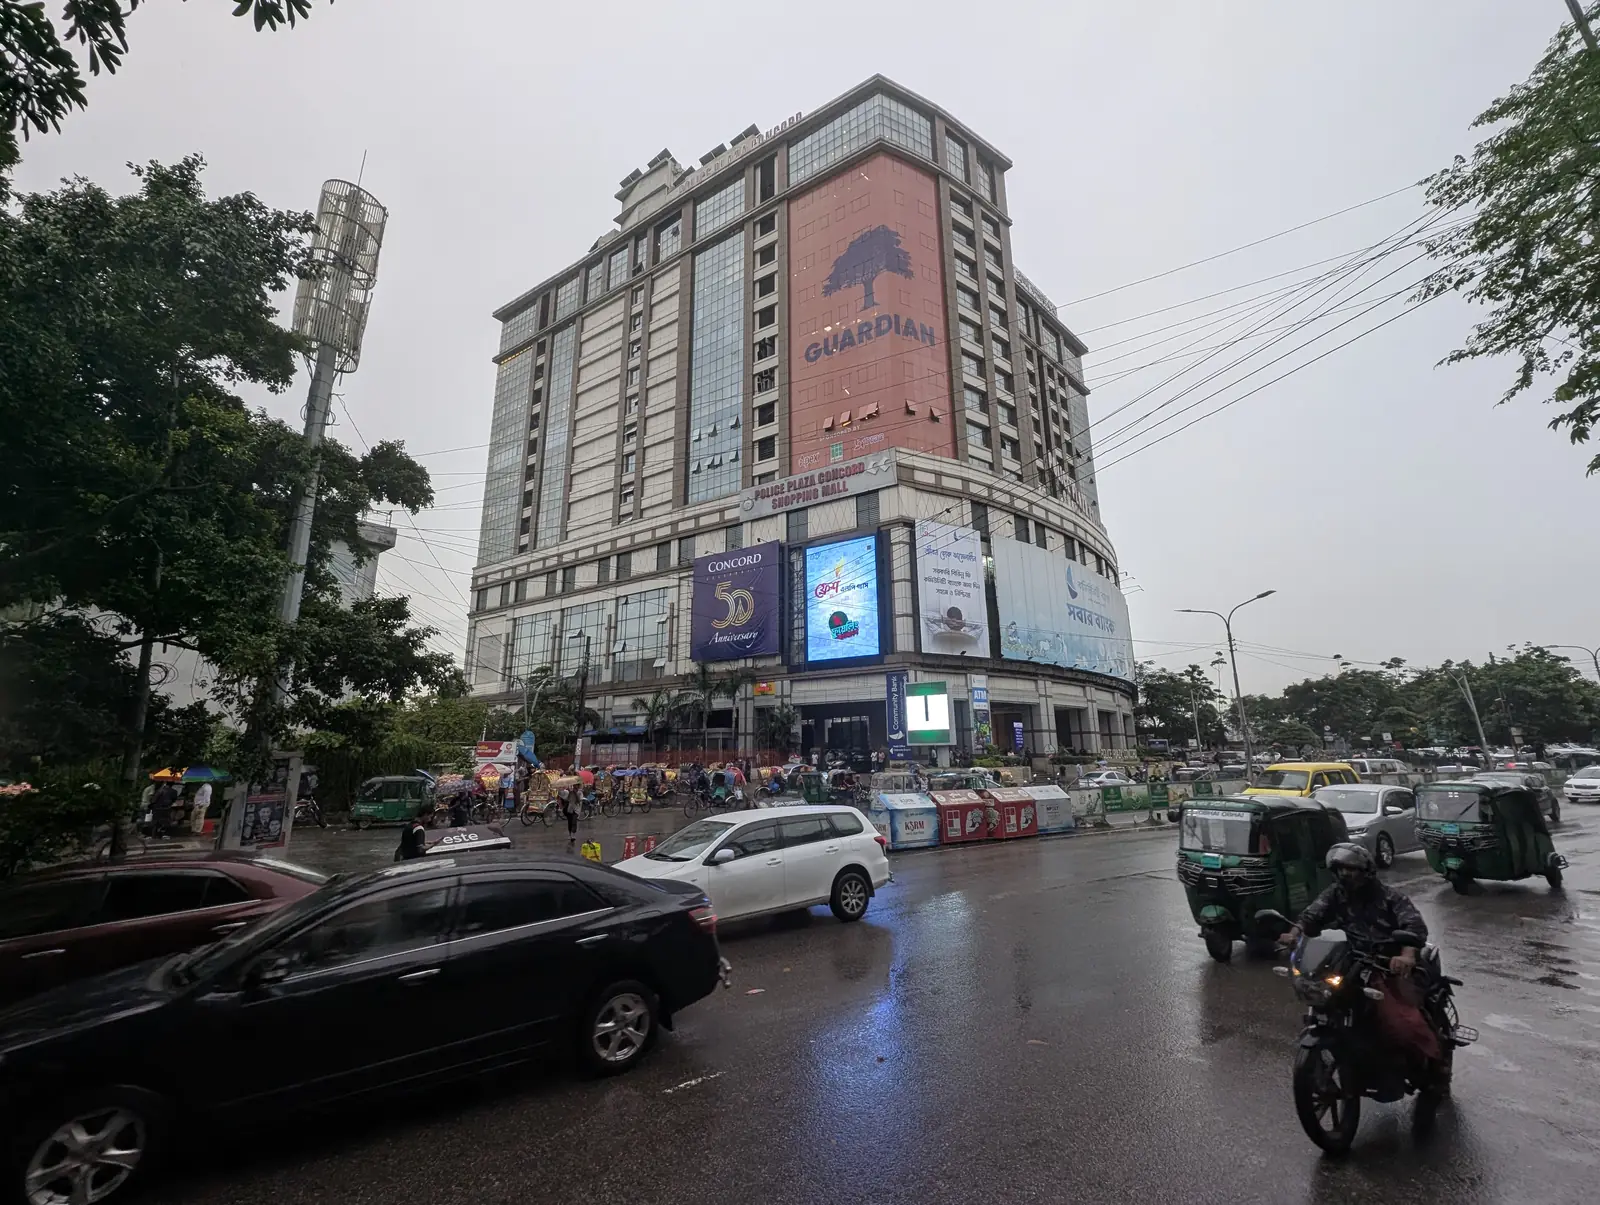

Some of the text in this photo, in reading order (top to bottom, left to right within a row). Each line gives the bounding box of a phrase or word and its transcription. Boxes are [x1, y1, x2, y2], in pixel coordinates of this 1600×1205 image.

[804, 313, 936, 363] GUARDIAN
[754, 461, 865, 501] POLICE PLAZA CONCORD
[771, 480, 849, 510] SHOPPING MALL
[707, 553, 762, 573] CONCORD
[1066, 602, 1094, 627] সবার
[708, 631, 759, 648] Anniversary
[974, 690, 987, 700] ATM
[904, 820, 925, 832] KSRM
[443, 833, 479, 844] este
